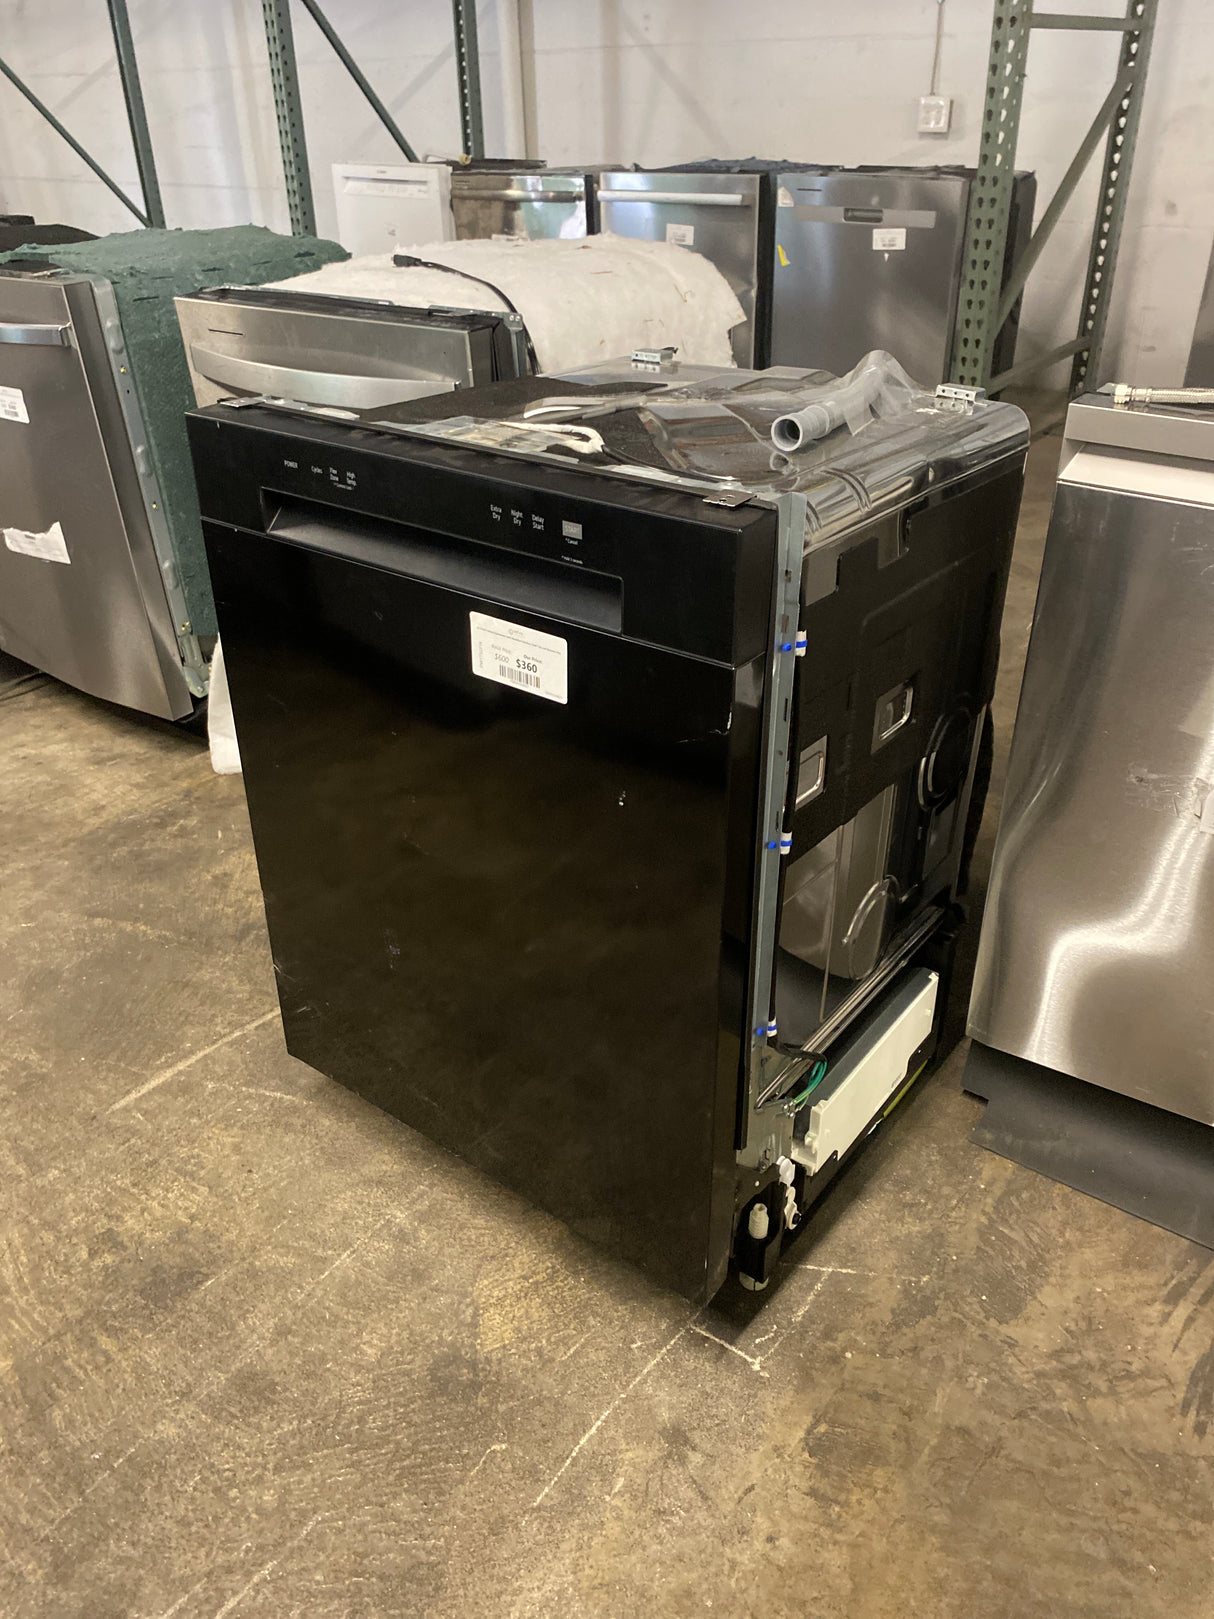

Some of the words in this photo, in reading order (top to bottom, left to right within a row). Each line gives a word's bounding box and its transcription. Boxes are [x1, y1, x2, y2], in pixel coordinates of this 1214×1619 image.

[490, 504, 502, 513] Extra
[511, 509, 523, 518] Night
[532, 514, 544, 524] Delay
[533, 522, 544, 530] Start
[515, 658, 538, 673] $360
